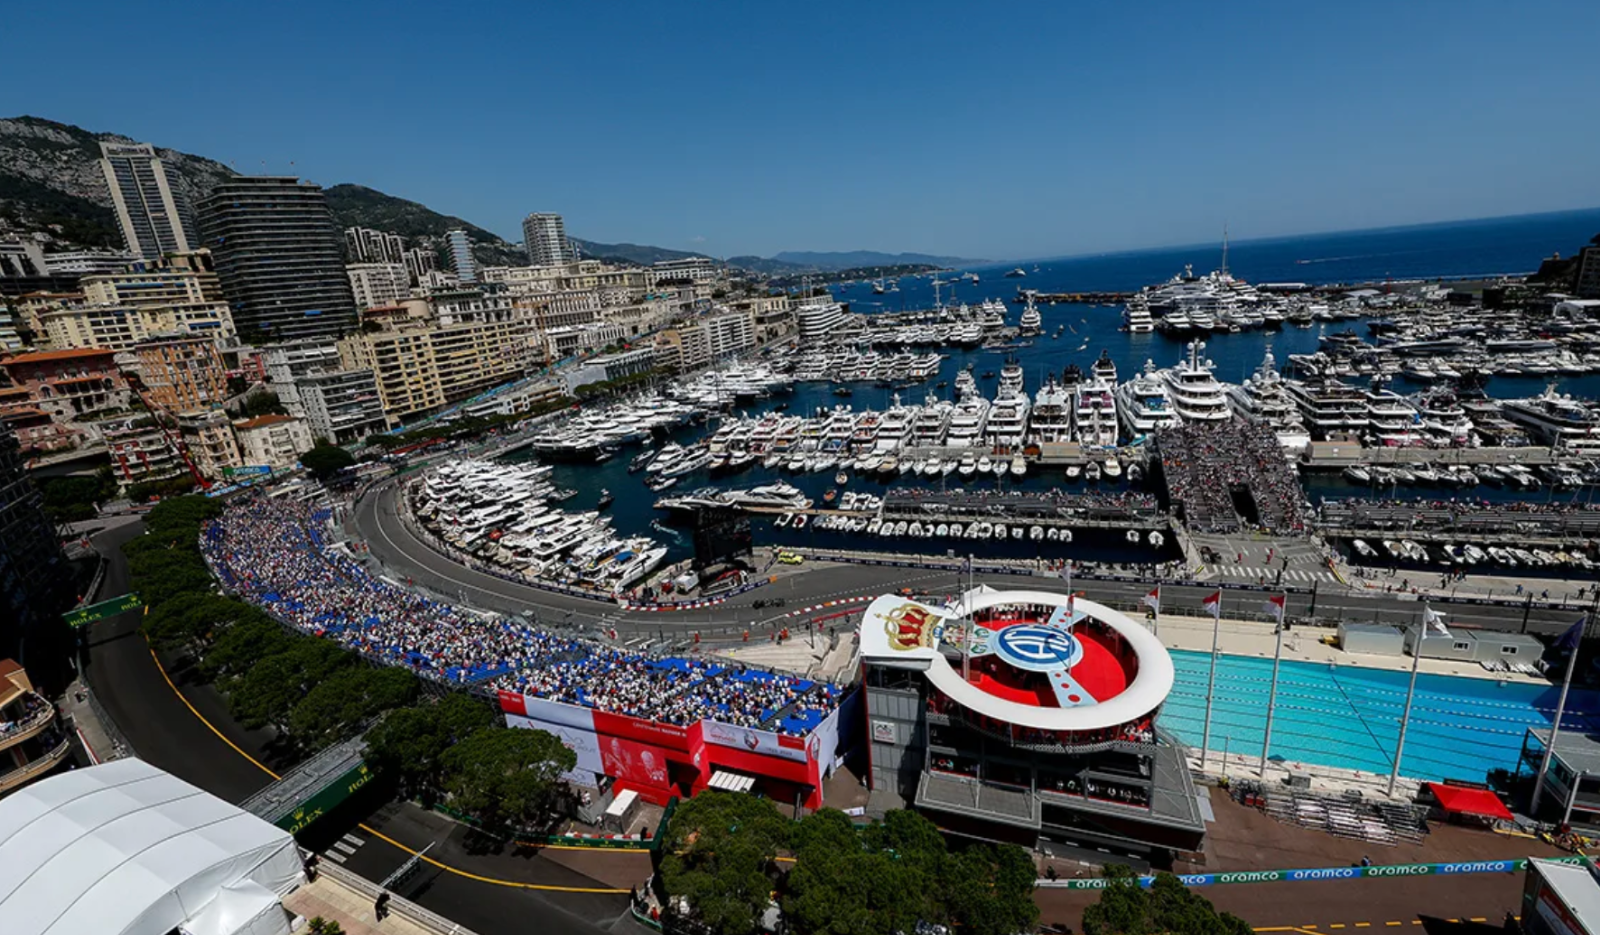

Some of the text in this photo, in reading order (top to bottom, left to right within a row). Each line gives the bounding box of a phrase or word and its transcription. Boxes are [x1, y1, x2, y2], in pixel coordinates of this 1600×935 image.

[120, 600, 142, 611] ROL
[69, 612, 102, 627] ROLEX
[348, 773, 375, 793] ROL
[289, 807, 323, 835] OLEX
[1220, 870, 1279, 882] aramco
[1293, 868, 1353, 879] aramco
[1368, 865, 1429, 876] aramco
[1444, 860, 1505, 873] aramco
